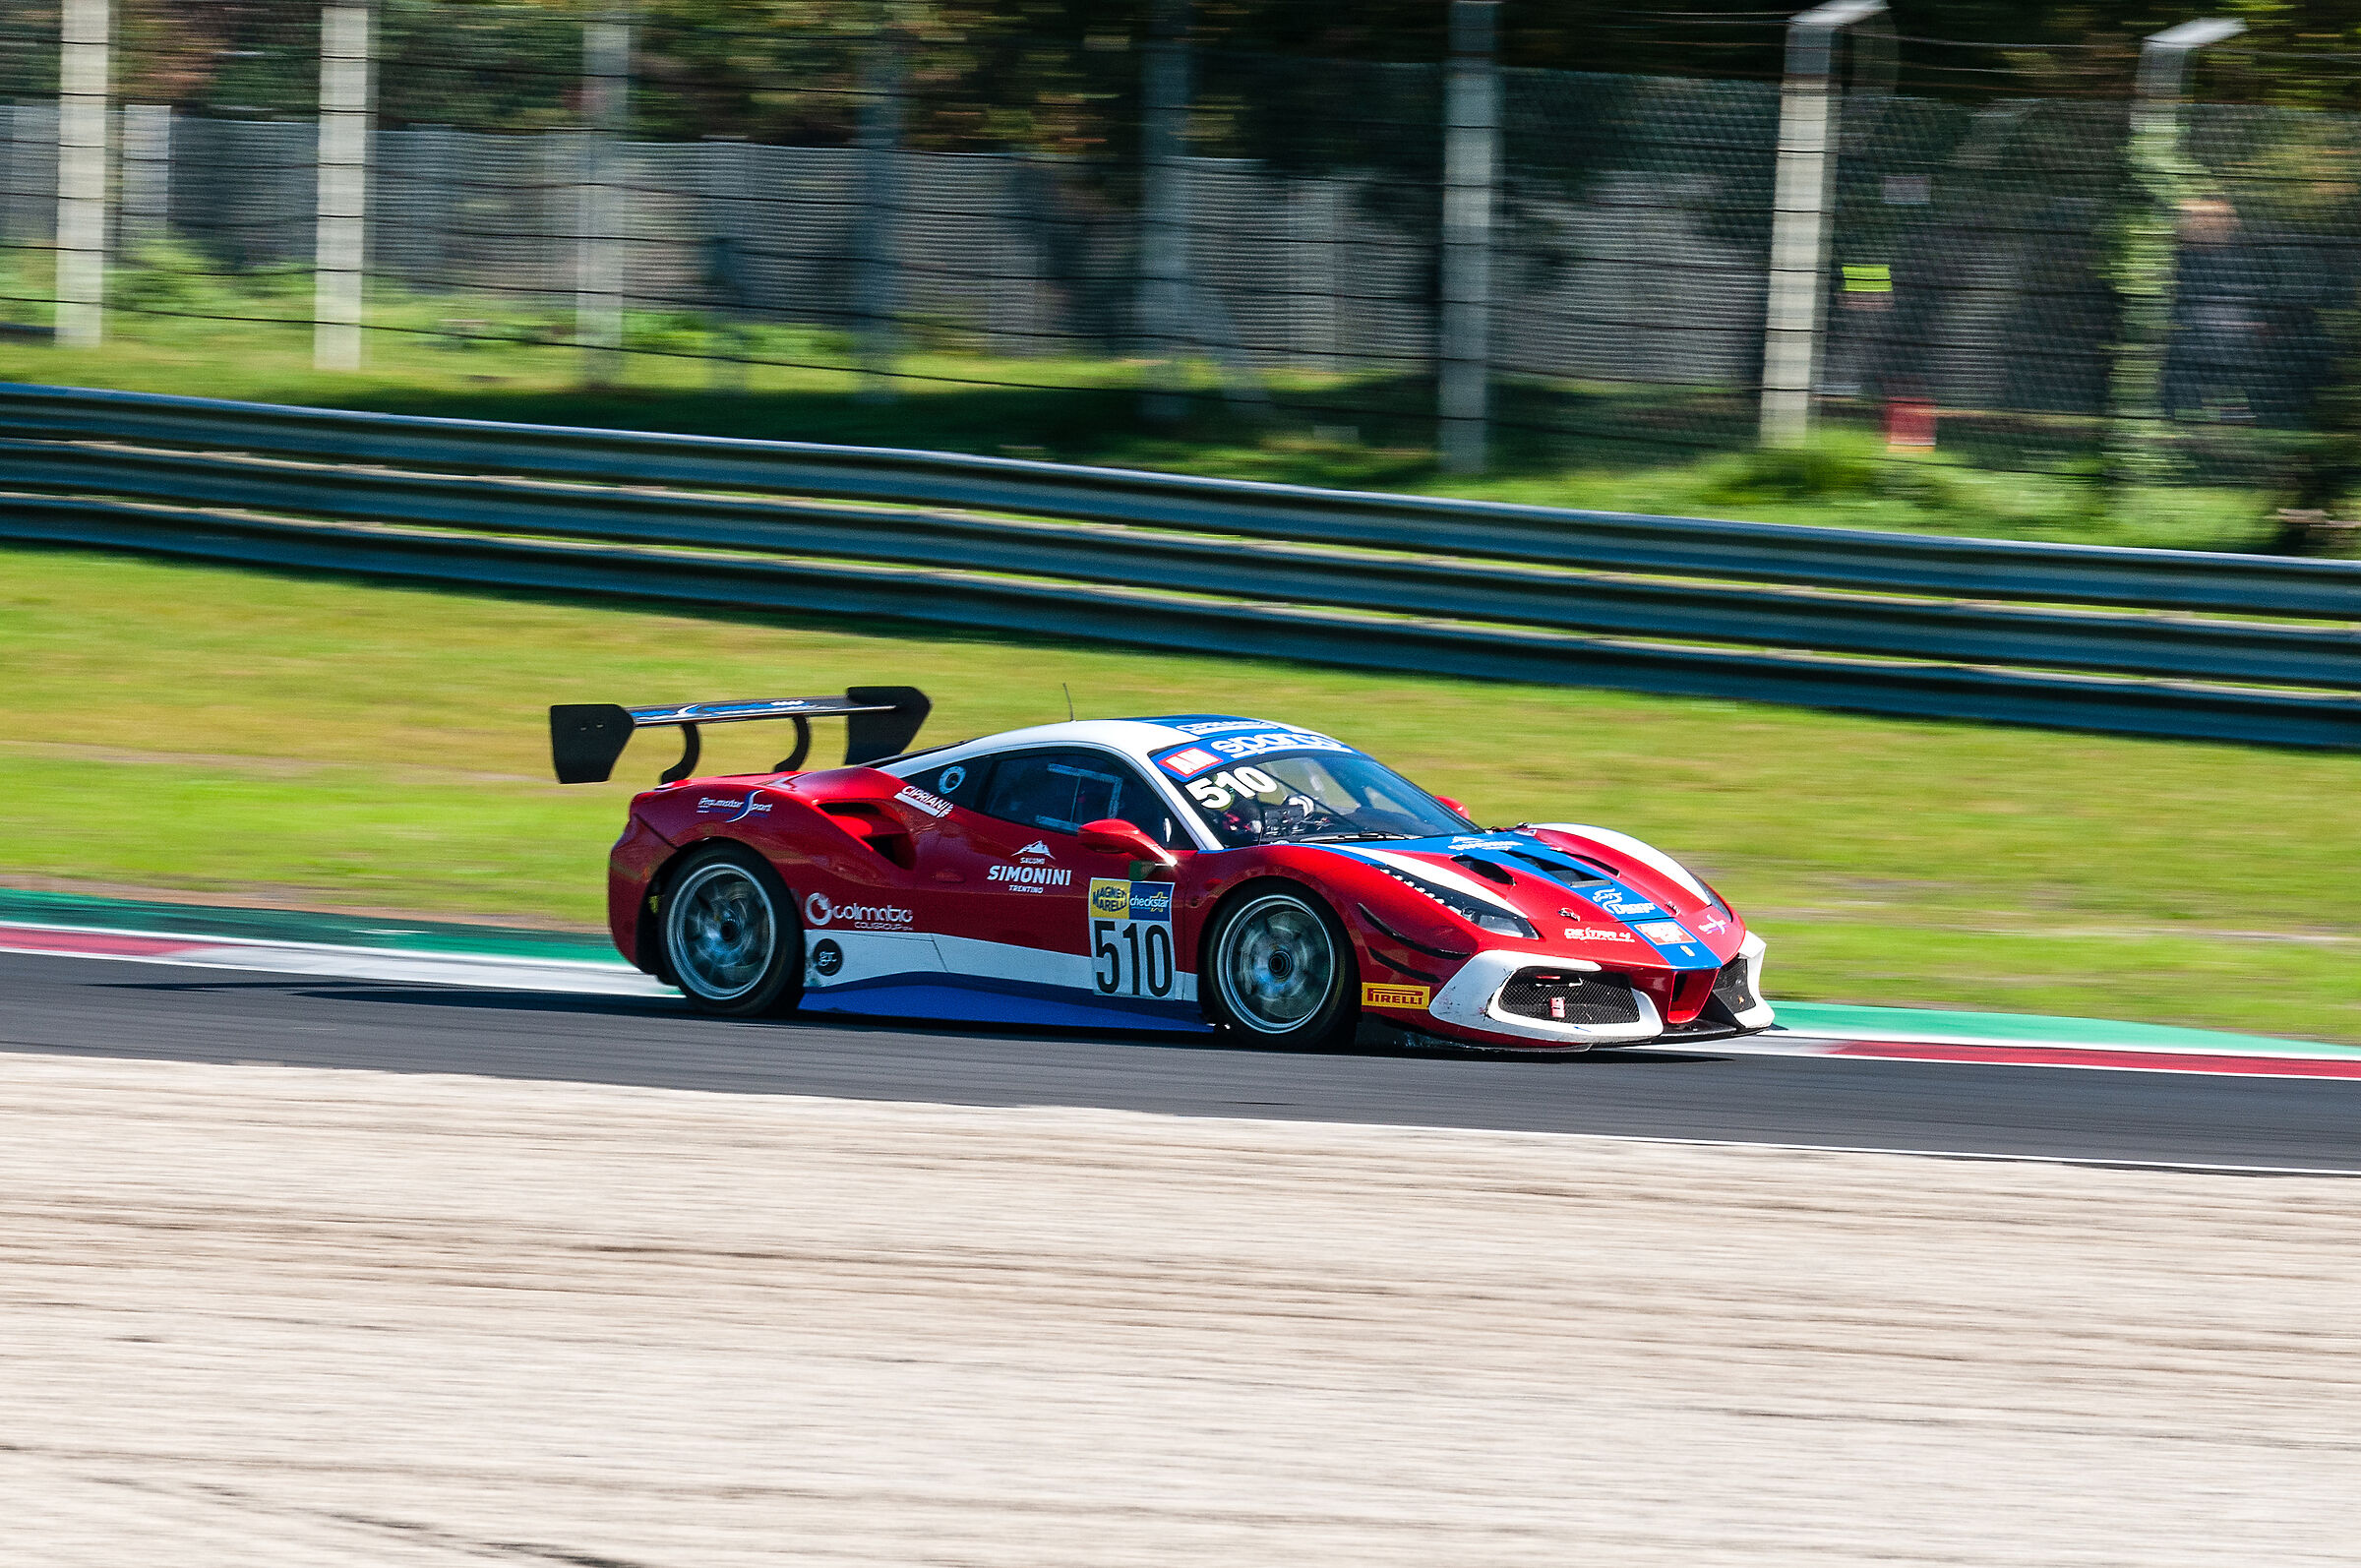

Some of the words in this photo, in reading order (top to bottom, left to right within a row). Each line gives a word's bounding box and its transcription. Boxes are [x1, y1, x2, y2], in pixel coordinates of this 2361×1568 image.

[1185, 766, 1278, 809] 510
[901, 785, 951, 812] CIPRIANI
[987, 865, 1072, 886] SIMONINI
[1008, 885, 1044, 894] TRENTINO
[1129, 894, 1170, 908] checkstar
[1094, 920, 1173, 997] 510
[1366, 988, 1424, 1005] PIRELLI
